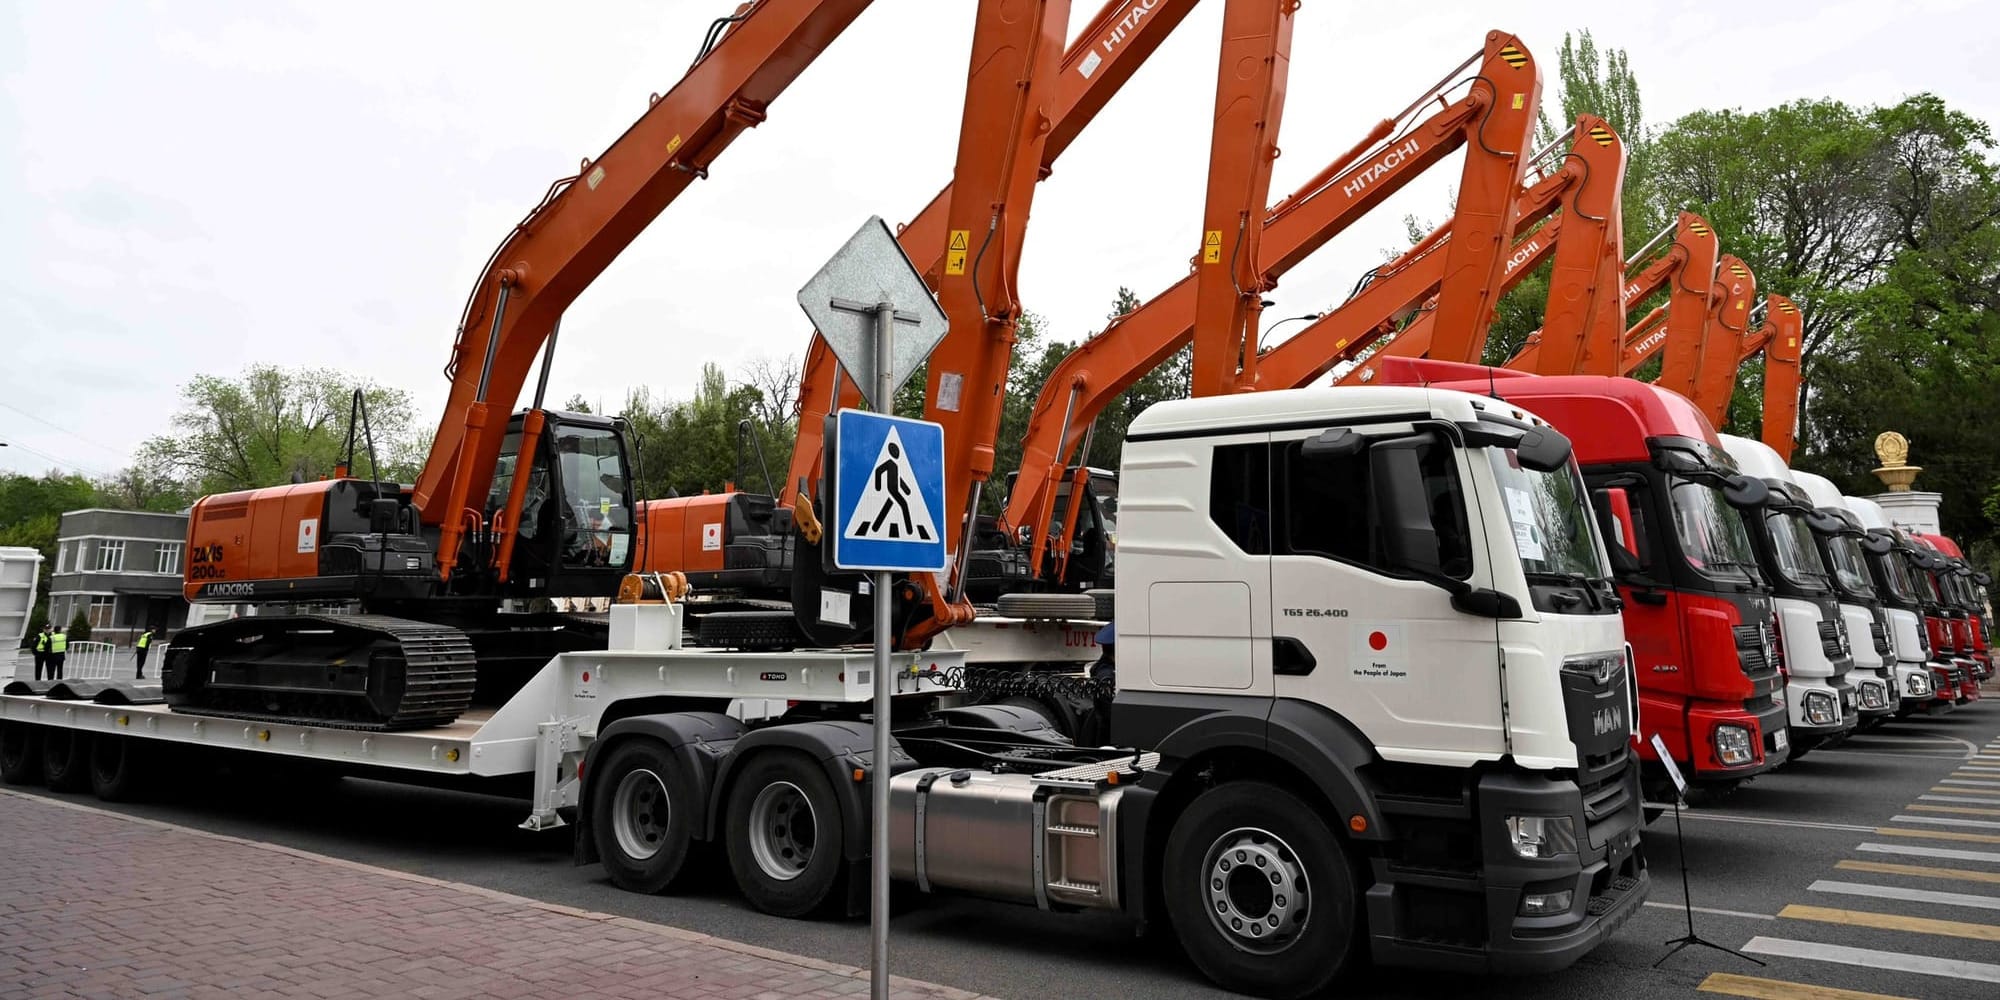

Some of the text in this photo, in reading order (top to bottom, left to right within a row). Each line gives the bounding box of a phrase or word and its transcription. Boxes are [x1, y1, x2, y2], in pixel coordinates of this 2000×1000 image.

[1343, 138, 1420, 198] HITACHI
[1504, 240, 1540, 275] ACHI
[1624, 283, 1641, 301] HI
[207, 582, 255, 596] LANDCROS
[1283, 608, 1349, 618] TGS 26.400
[1372, 661, 1387, 669] From
[1363, 669, 1382, 678] People
[1382, 669, 1389, 677] of
[1389, 669, 1407, 678] Japan
[1592, 705, 1622, 736] MAN
